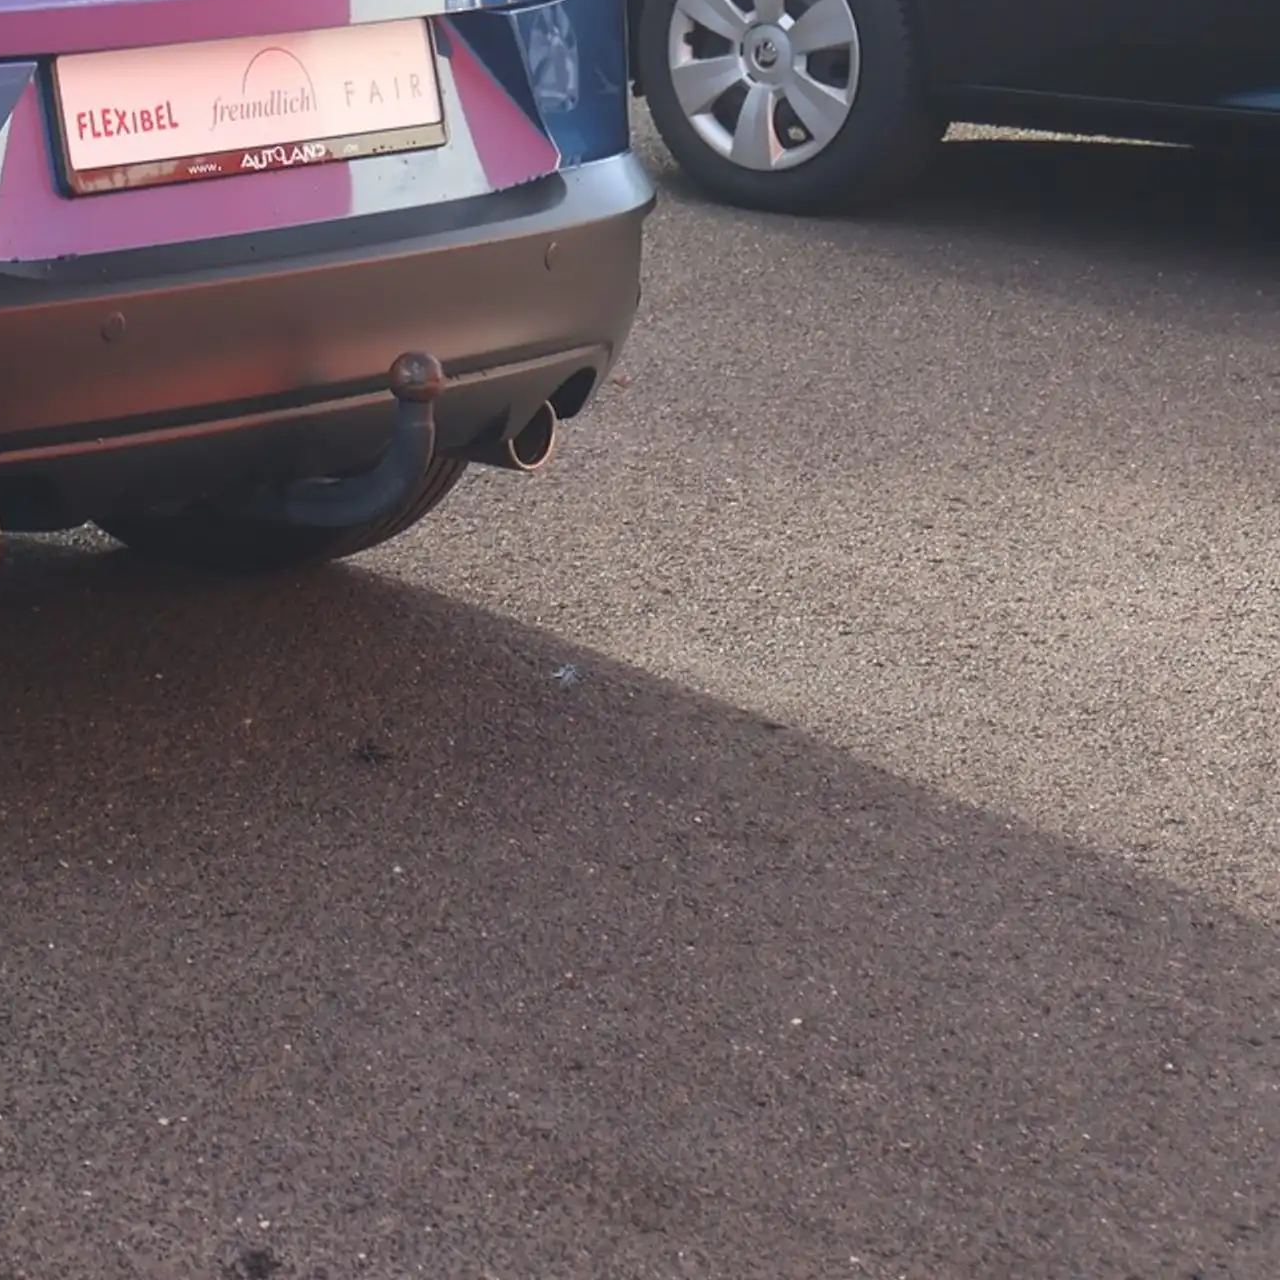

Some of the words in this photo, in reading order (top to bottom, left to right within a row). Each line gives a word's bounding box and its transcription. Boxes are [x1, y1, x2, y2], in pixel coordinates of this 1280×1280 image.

[76, 100, 179, 140] FLEXIBEL
[208, 87, 311, 132] freundlich
[343, 73, 423, 108] FAIR
